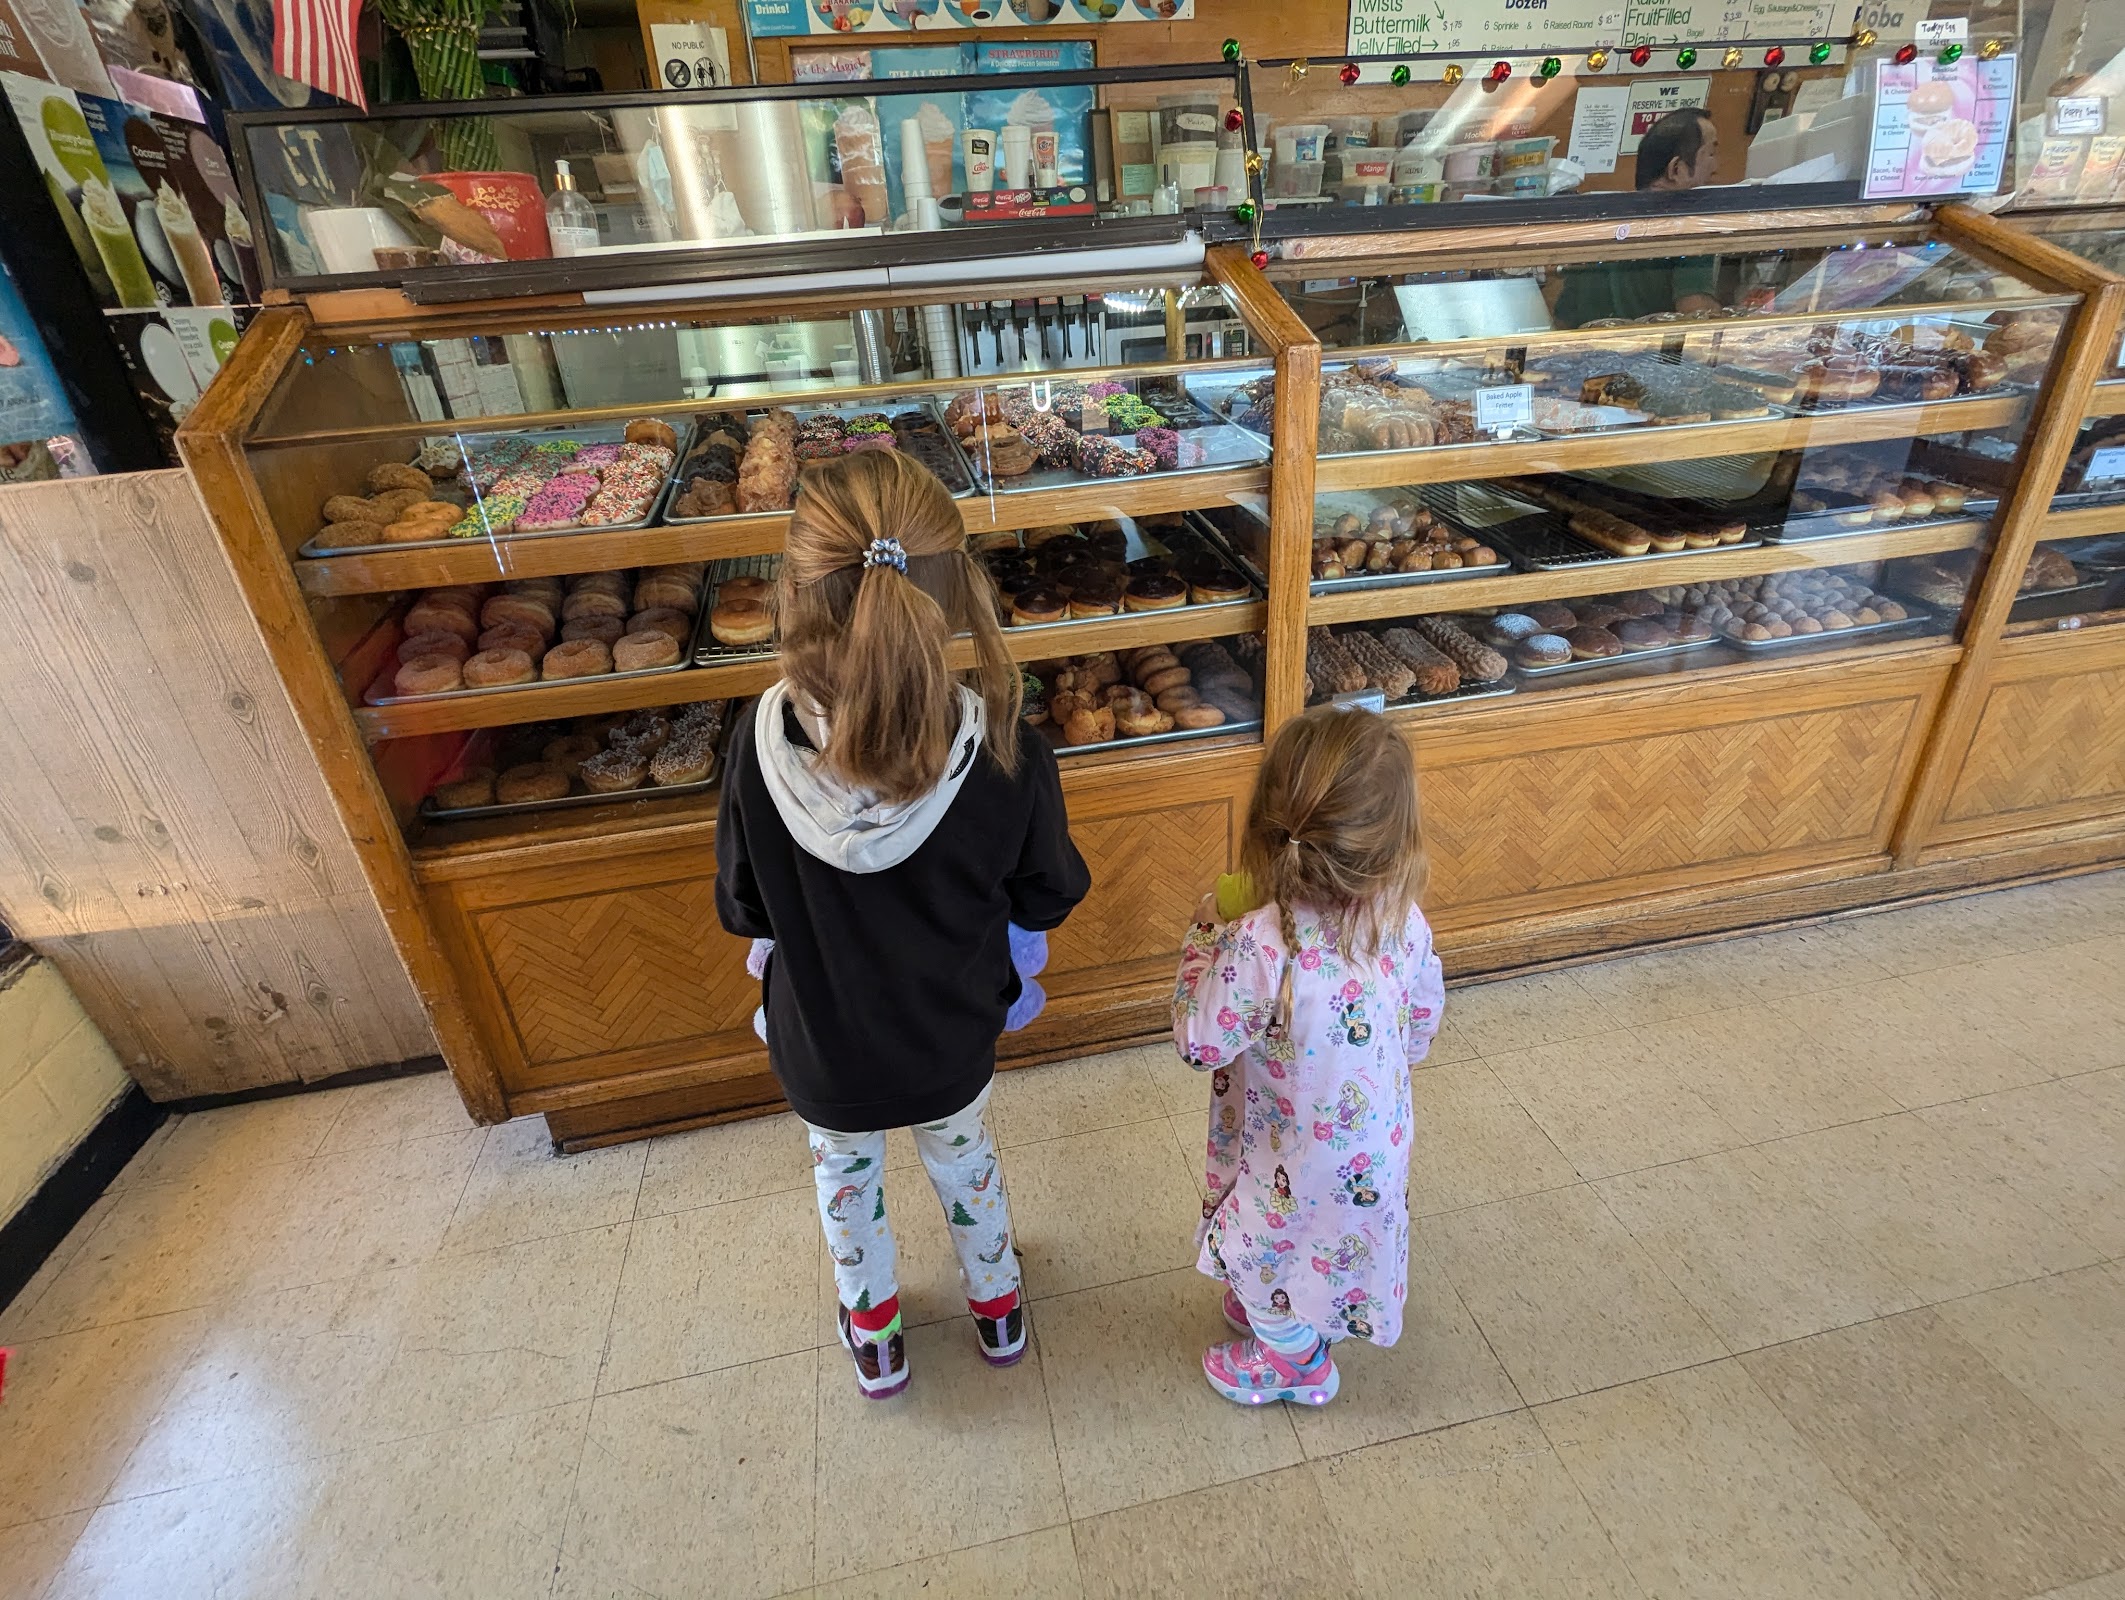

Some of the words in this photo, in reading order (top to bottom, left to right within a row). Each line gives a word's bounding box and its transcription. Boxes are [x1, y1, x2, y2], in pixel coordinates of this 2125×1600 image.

[755, 3, 790, 15] Drinks!
[1505, 0, 1548, 10] Dozen
[1753, 4, 1765, 15] Egg
[1627, 6, 1692, 27] FruitFilled
[1353, 14, 1431, 35] Buttermilk
[1484, 21, 1490, 31] 6
[1493, 21, 1520, 32] Sprinkle
[1543, 19, 1549, 30] 6
[1549, 20, 1572, 30] Raised
[1572, 19, 1594, 29] Round
[1625, 32, 1658, 47] Plain
[1686, 28, 1705, 39] Bagel
[671, 41, 682, 50] NO
[683, 40, 705, 50] PUBLIC
[1351, 38, 1385, 56] Jelly
[1386, 36, 1422, 55] Filled
[988, 48, 1061, 59] STRAWBERRY
[888, 69, 926, 79] THAI
[1659, 86, 1680, 96] WE
[1631, 99, 1663, 110] RESERVE
[1664, 98, 1679, 109] THE
[1680, 97, 1702, 108] RIGHT
[1641, 113, 1653, 123] TO
[131, 145, 166, 161] Coconut
[1362, 164, 1385, 175] Mango
[1486, 393, 1504, 401] Baked
[1505, 391, 1523, 399] Apple
